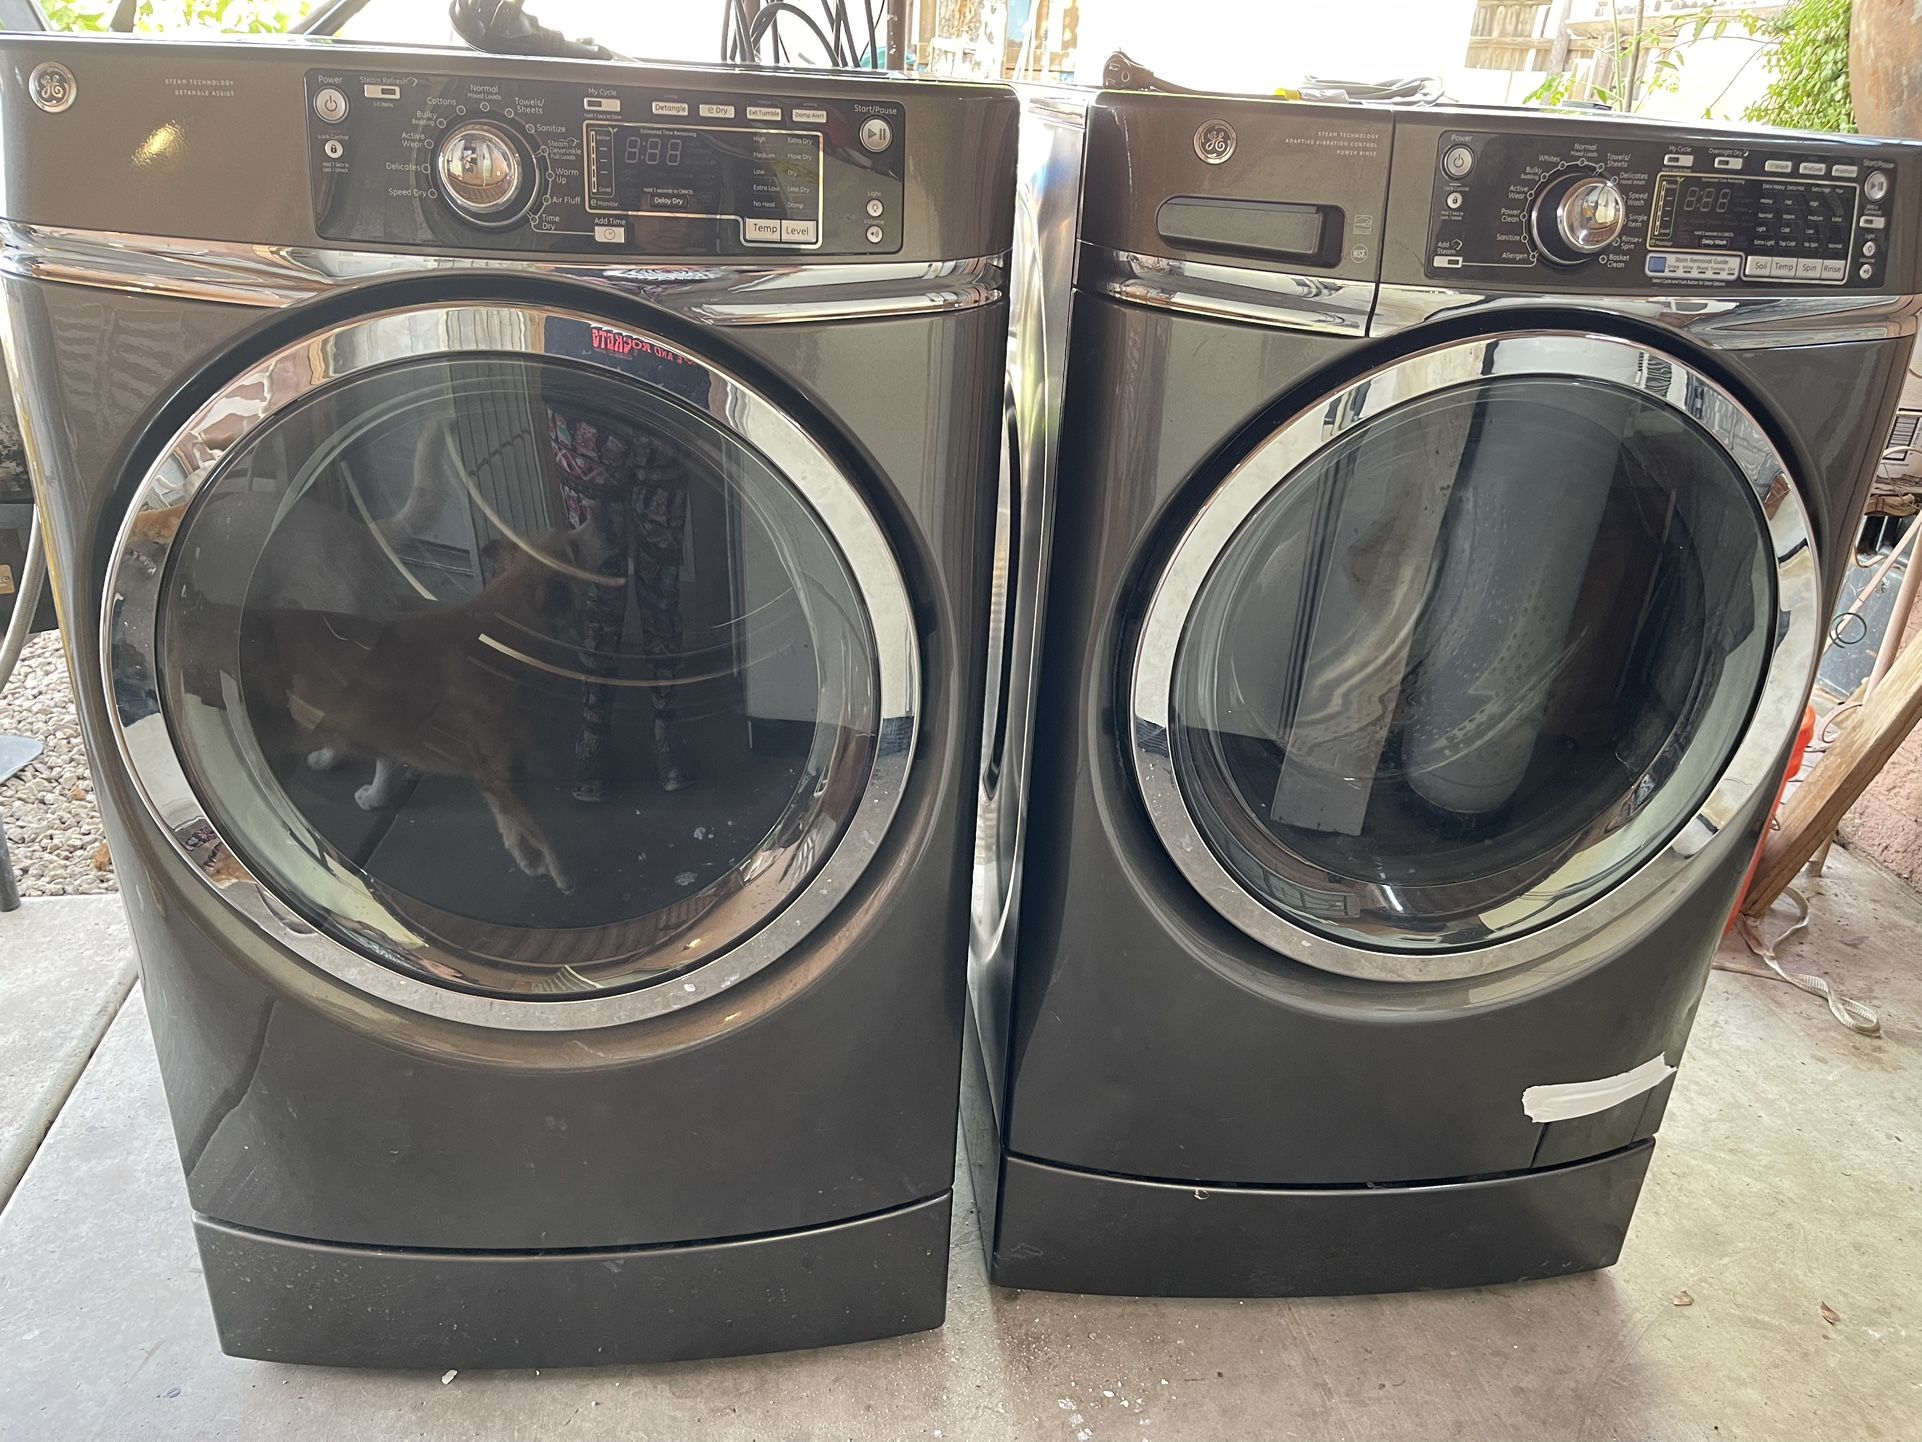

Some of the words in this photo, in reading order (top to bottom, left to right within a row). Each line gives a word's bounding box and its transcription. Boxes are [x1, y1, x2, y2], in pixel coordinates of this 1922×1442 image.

[318, 75, 342, 84] Power
[360, 76, 381, 84] Steam
[382, 77, 409, 85] Refresh
[470, 84, 499, 93] Normal
[588, 88, 597, 96] My
[599, 88, 616, 96] Cycle
[427, 97, 456, 105] Cottons
[515, 97, 545, 106] Towels/
[517, 106, 543, 114] Sheets
[655, 103, 687, 113] Detangle
[715, 107, 728, 115] Dry
[854, 104, 898, 114] Start/Pause
[417, 111, 437, 119] Bulky
[536, 124, 566, 132] Sanitize
[402, 132, 425, 140] Active
[753, 136, 767, 144] High
[1574, 143, 1597, 151] Normal
[1708, 148, 1733, 156] Overnight
[1733, 149, 1743, 157] Dry
[1539, 154, 1560, 162] Whites
[1607, 153, 1632, 161] Towels/
[386, 162, 421, 170] Delicates
[1606, 160, 1628, 168] Sheets
[1525, 166, 1542, 174] Bulky
[556, 176, 567, 184] Up
[1620, 172, 1648, 180] Delicates
[389, 188, 412, 197] Speed
[414, 189, 427, 198] Dry
[1628, 192, 1648, 200] Speed
[564, 196, 581, 204] Fluff
[654, 197, 671, 205] Delay
[672, 198, 684, 206] Dry
[542, 214, 560, 222] Time
[594, 217, 608, 225] Add
[609, 218, 626, 226] Time
[1501, 215, 1519, 223] Clean
[1629, 214, 1648, 223] Single
[542, 222, 556, 231] Dry
[1627, 220, 1642, 228] Item
[754, 223, 778, 234] Temp
[786, 226, 809, 235] Level
[1496, 233, 1521, 241] Sanitize
[1621, 242, 1635, 250] Spin
[1502, 252, 1528, 260] Allergen
[1755, 261, 1768, 270] Soil
[1775, 262, 1794, 271] Temp
[1802, 264, 1817, 272] Spin
[1823, 265, 1842, 273] Rinse
